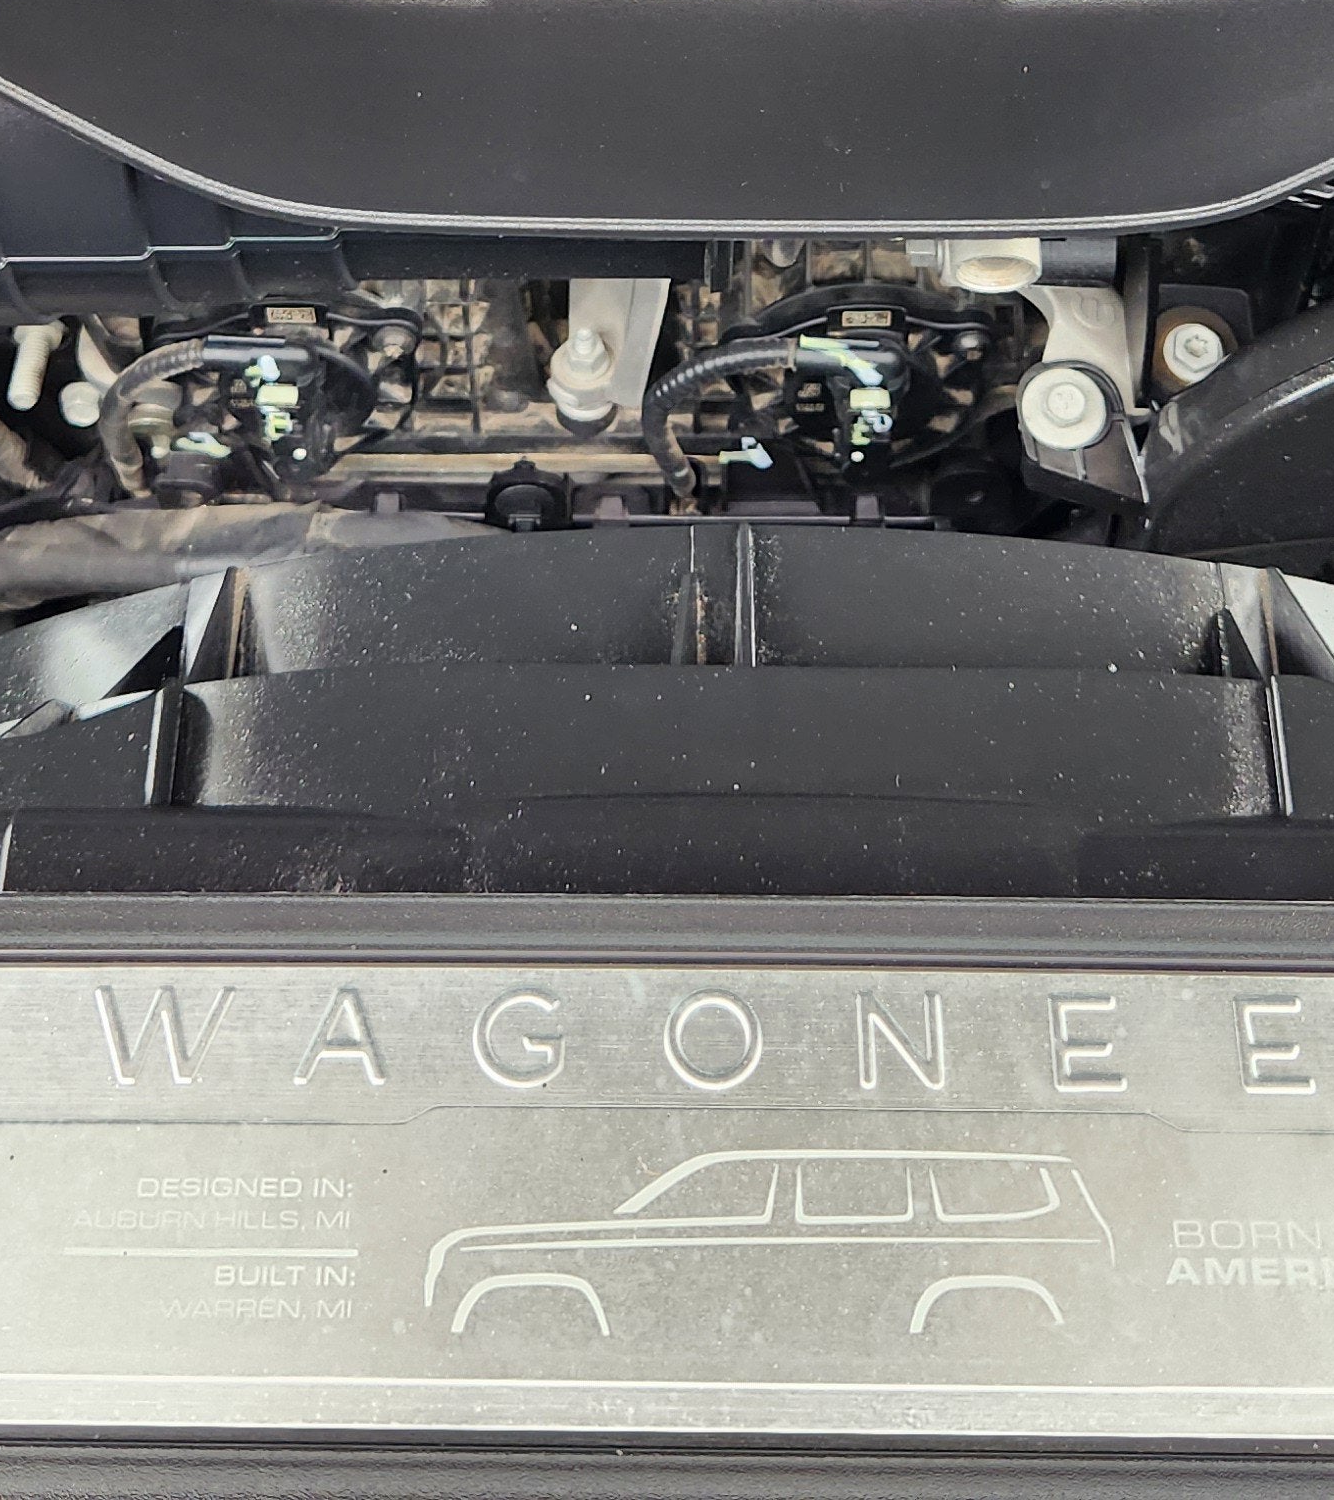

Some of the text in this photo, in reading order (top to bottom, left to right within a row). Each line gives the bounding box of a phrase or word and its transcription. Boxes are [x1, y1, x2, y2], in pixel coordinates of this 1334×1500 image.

[136, 1177, 354, 1199] DESIGNED IN:
[72, 1209, 351, 1232] AUBURN HILLS, MI
[1172, 1218, 1322, 1250] BORN
[215, 1264, 357, 1288] BUILT IN:
[165, 1298, 352, 1321] WARREN, MI
